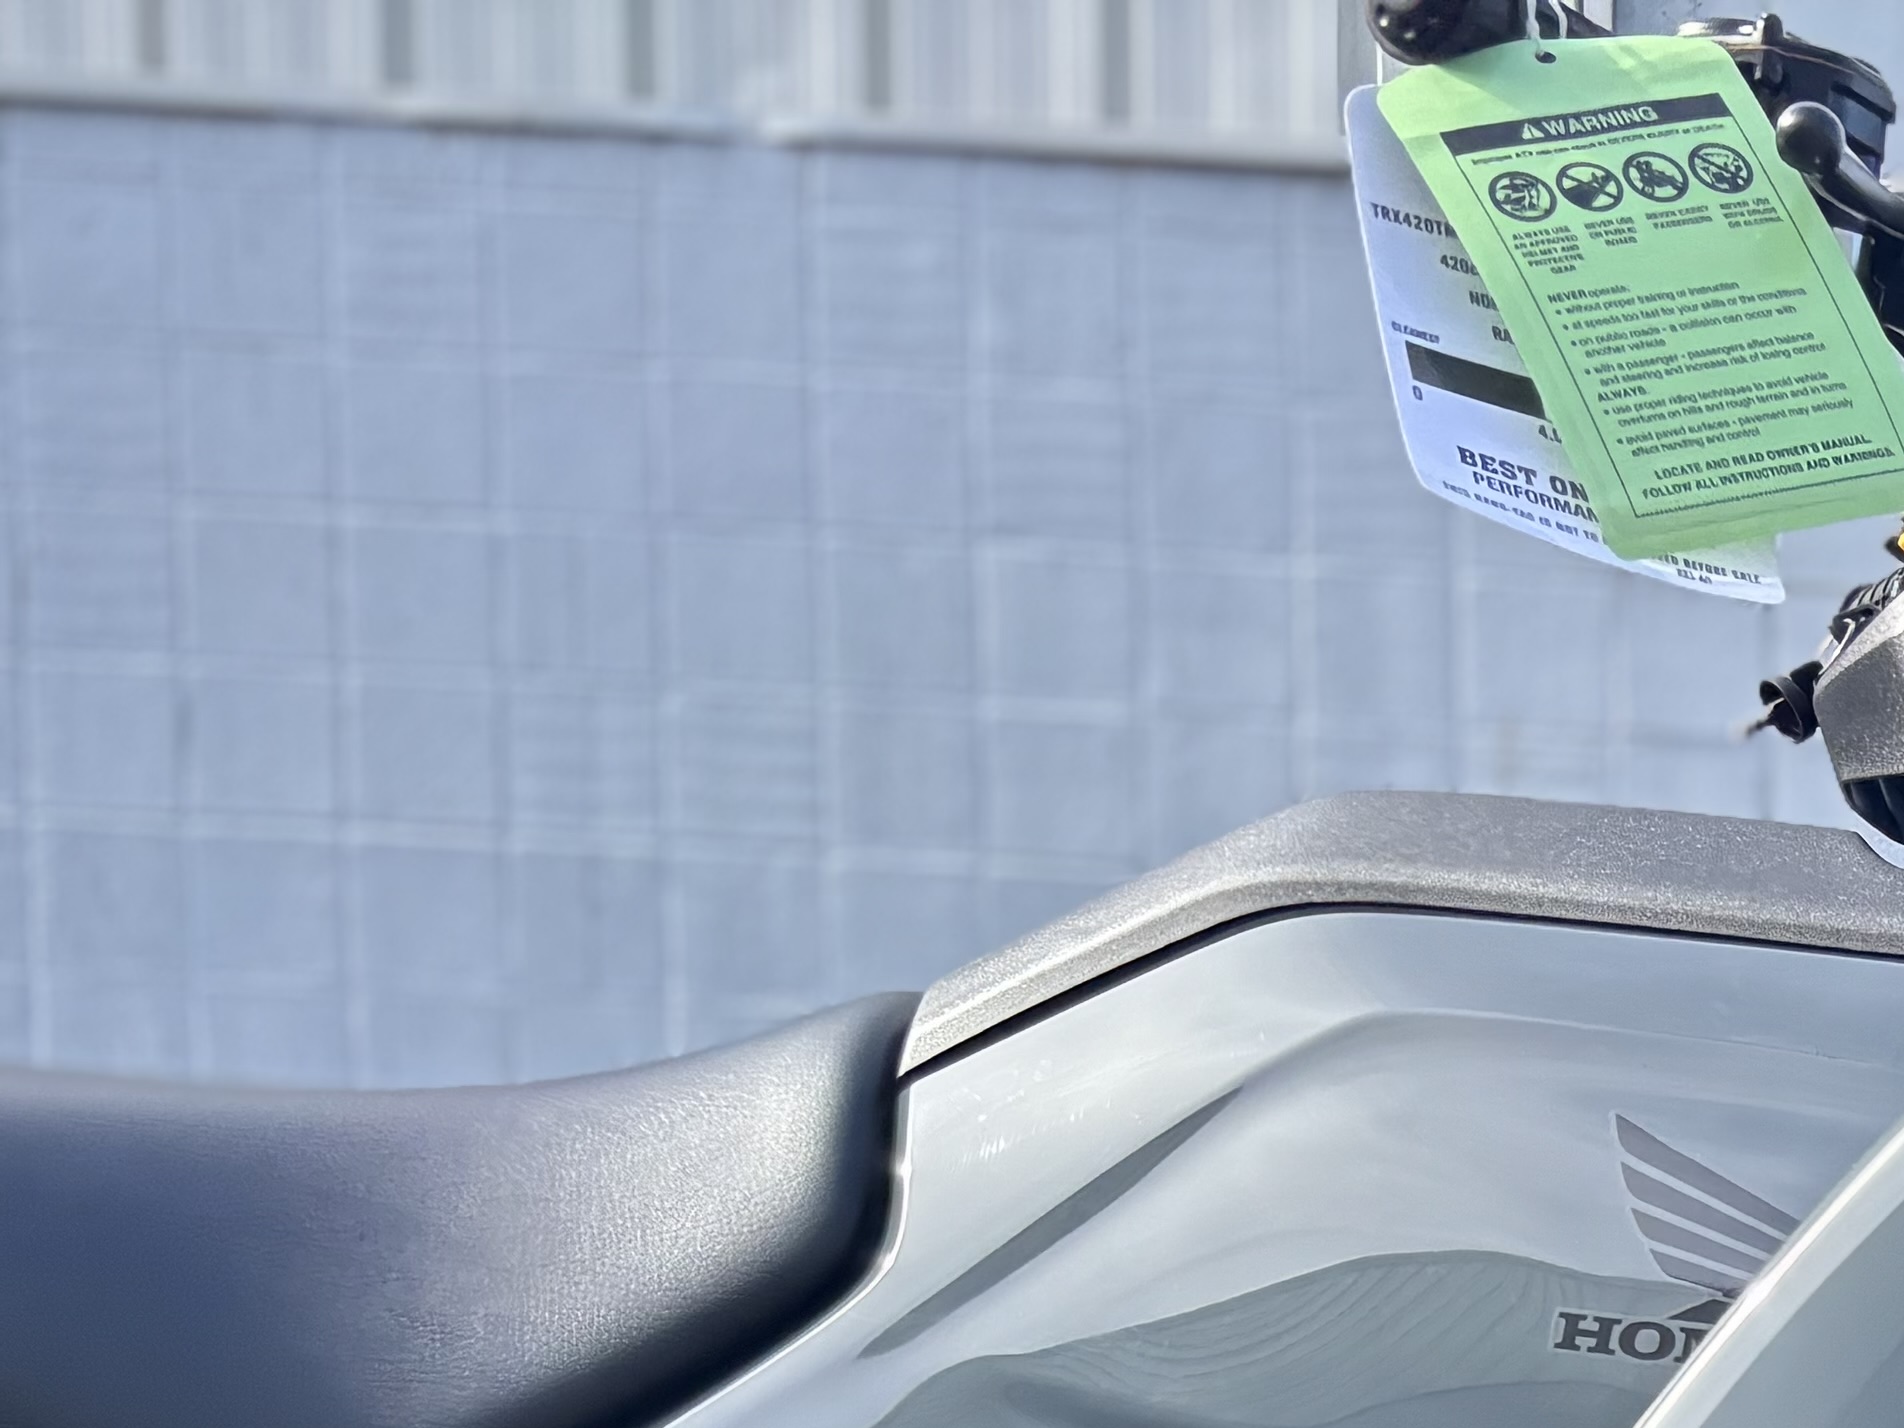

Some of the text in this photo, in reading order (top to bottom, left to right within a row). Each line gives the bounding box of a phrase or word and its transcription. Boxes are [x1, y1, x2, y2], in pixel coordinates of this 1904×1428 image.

[1541, 106, 1658, 136] WARNING
[1547, 289, 1587, 304] NEVER
[1565, 302, 1602, 314] without
[1603, 297, 1635, 310] proper
[1637, 291, 1676, 304] training
[1687, 282, 1740, 297] instruction
[1583, 315, 1621, 329] speeds
[1676, 304, 1698, 315] your
[1701, 299, 1726, 310] skills
[1594, 331, 1628, 344] public
[1629, 327, 1661, 338] roads
[1679, 317, 1722, 331] collision
[1722, 314, 1743, 324] can
[1744, 309, 1773, 320] occur
[1775, 305, 1797, 315] with
[1585, 338, 1667, 358] another vehicle
[1592, 363, 1615, 374] with
[1626, 354, 1679, 370] passenger
[1686, 343, 1746, 360] passengers
[1774, 332, 1815, 345] balance
[1600, 375, 1620, 387] and
[1621, 370, 1664, 383] steering
[1664, 365, 1683, 376] and
[1684, 359, 1728, 373] increase
[1760, 349, 1792, 361] losing
[1412, 385, 1423, 401] 0
[1611, 405, 1632, 415] use
[1633, 399, 1667, 412] proper
[1668, 393, 1698, 405] riding
[1698, 385, 1752, 400] techniques
[1765, 376, 1793, 389] avoid
[1793, 371, 1829, 384] vehicle
[1618, 412, 1667, 427] overturns
[1667, 410, 1681, 419] on
[1681, 405, 1703, 416] hills
[1704, 401, 1724, 413] and
[1725, 397, 1755, 409] rough
[1756, 392, 1789, 403] terrain
[1789, 387, 1810, 398] and
[1821, 382, 1847, 393] turns
[1625, 397, 1853, 445] avoid paved surfaces pavement may seriously
[1705, 433, 1726, 444] and
[1726, 427, 1761, 440] control
[1456, 445, 1537, 486] BEST
[1642, 481, 1692, 500] FOLLOW
[1695, 477, 1719, 491] ALL
[1718, 462, 1804, 486] INSTRUCTIONS
[1806, 457, 1831, 471] AND
[1654, 462, 1703, 480] LOCATE
[1705, 458, 1730, 471] AND
[1732, 452, 1765, 467] READ
[1766, 442, 1821, 461] OWNER'S
[1683, 558, 1728, 576] BEFORE
